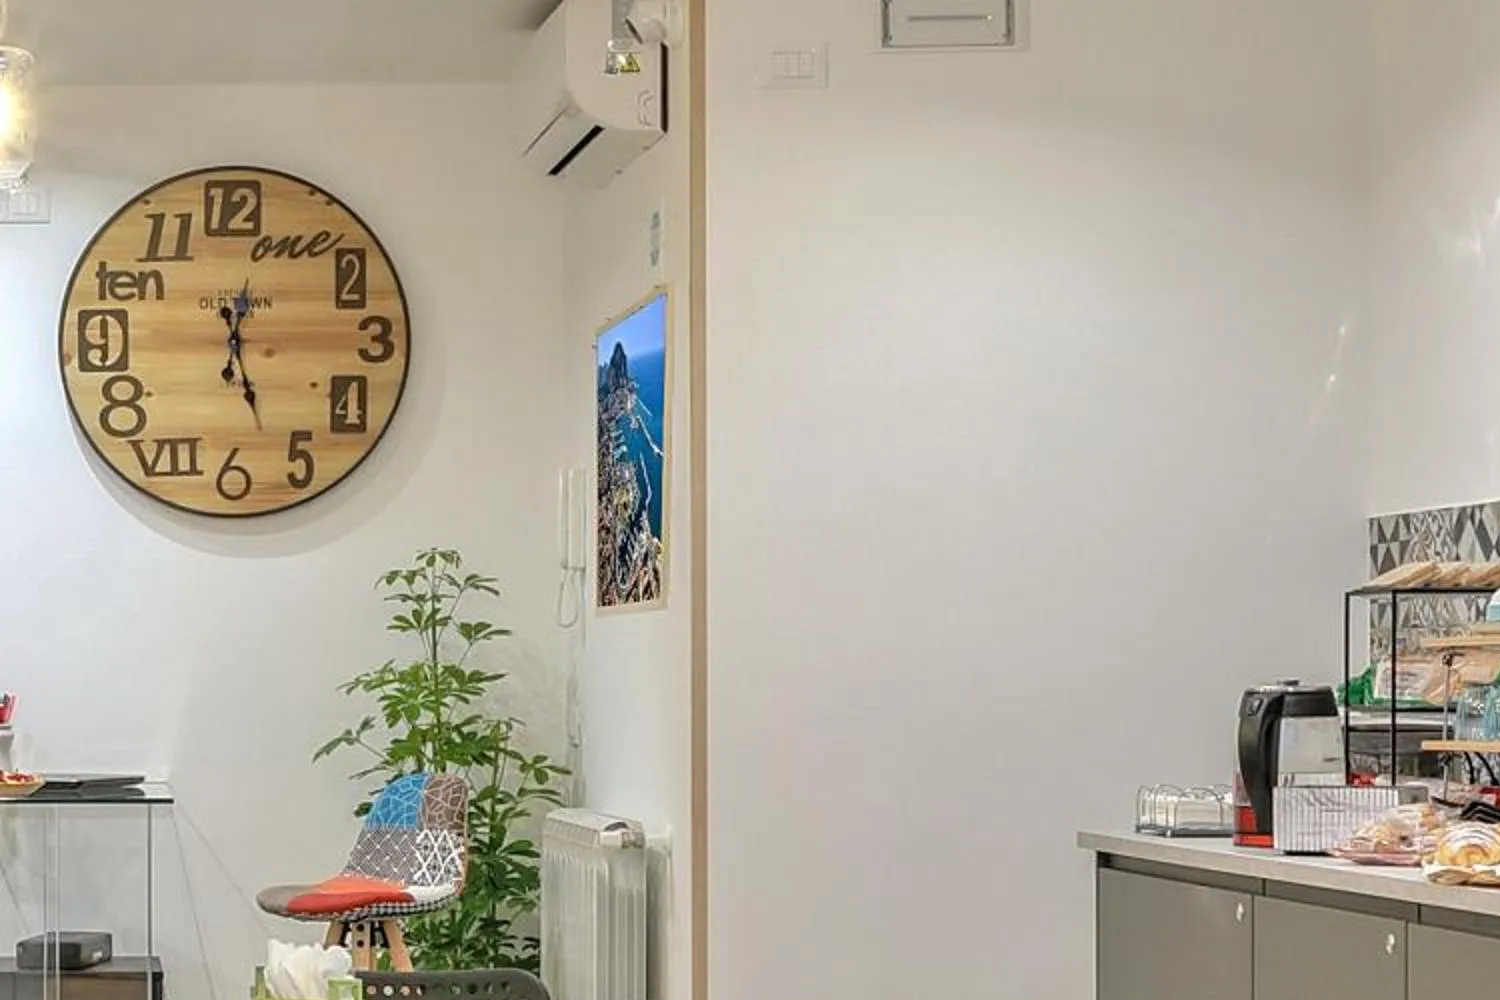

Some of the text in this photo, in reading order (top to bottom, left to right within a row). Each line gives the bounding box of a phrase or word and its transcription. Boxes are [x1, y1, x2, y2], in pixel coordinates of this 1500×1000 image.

[207, 187, 257, 231] 12
[136, 212, 195, 262] 11
[251, 230, 345, 262] one
[96, 262, 165, 301] ten
[339, 252, 363, 301] 2
[84, 314, 125, 367] 9
[357, 315, 396, 363] 3
[99, 374, 148, 438] 8
[334, 380, 364, 427] 4
[128, 437, 204, 477] VII
[215, 447, 252, 501] 6
[286, 430, 315, 489] 5
